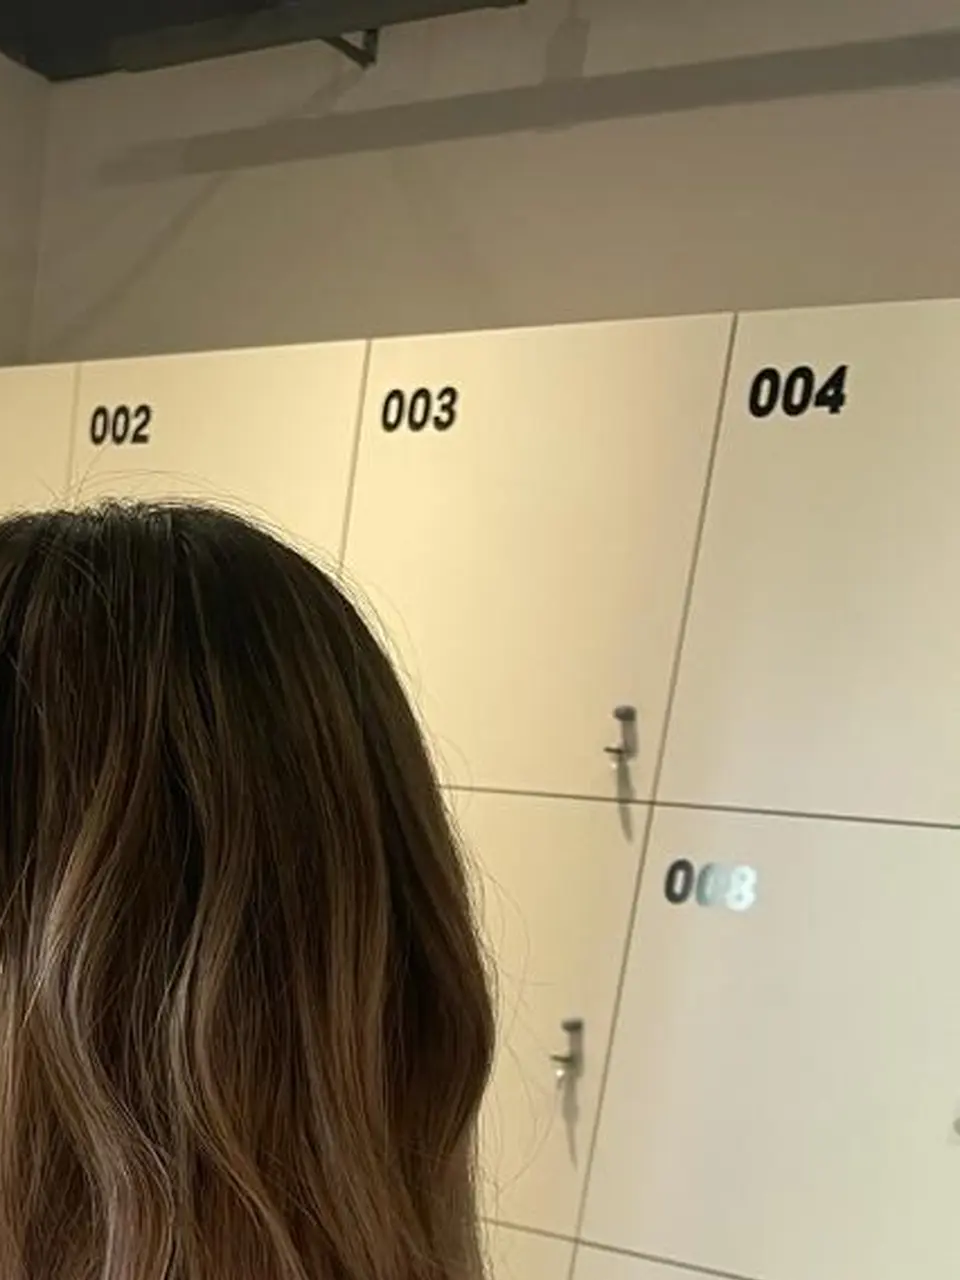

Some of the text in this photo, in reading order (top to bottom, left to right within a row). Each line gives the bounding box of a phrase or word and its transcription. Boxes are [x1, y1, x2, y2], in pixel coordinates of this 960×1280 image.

[381, 386, 458, 432] 003
[749, 364, 848, 418] 004
[89, 404, 152, 446] 002
[664, 858, 758, 912] 008
